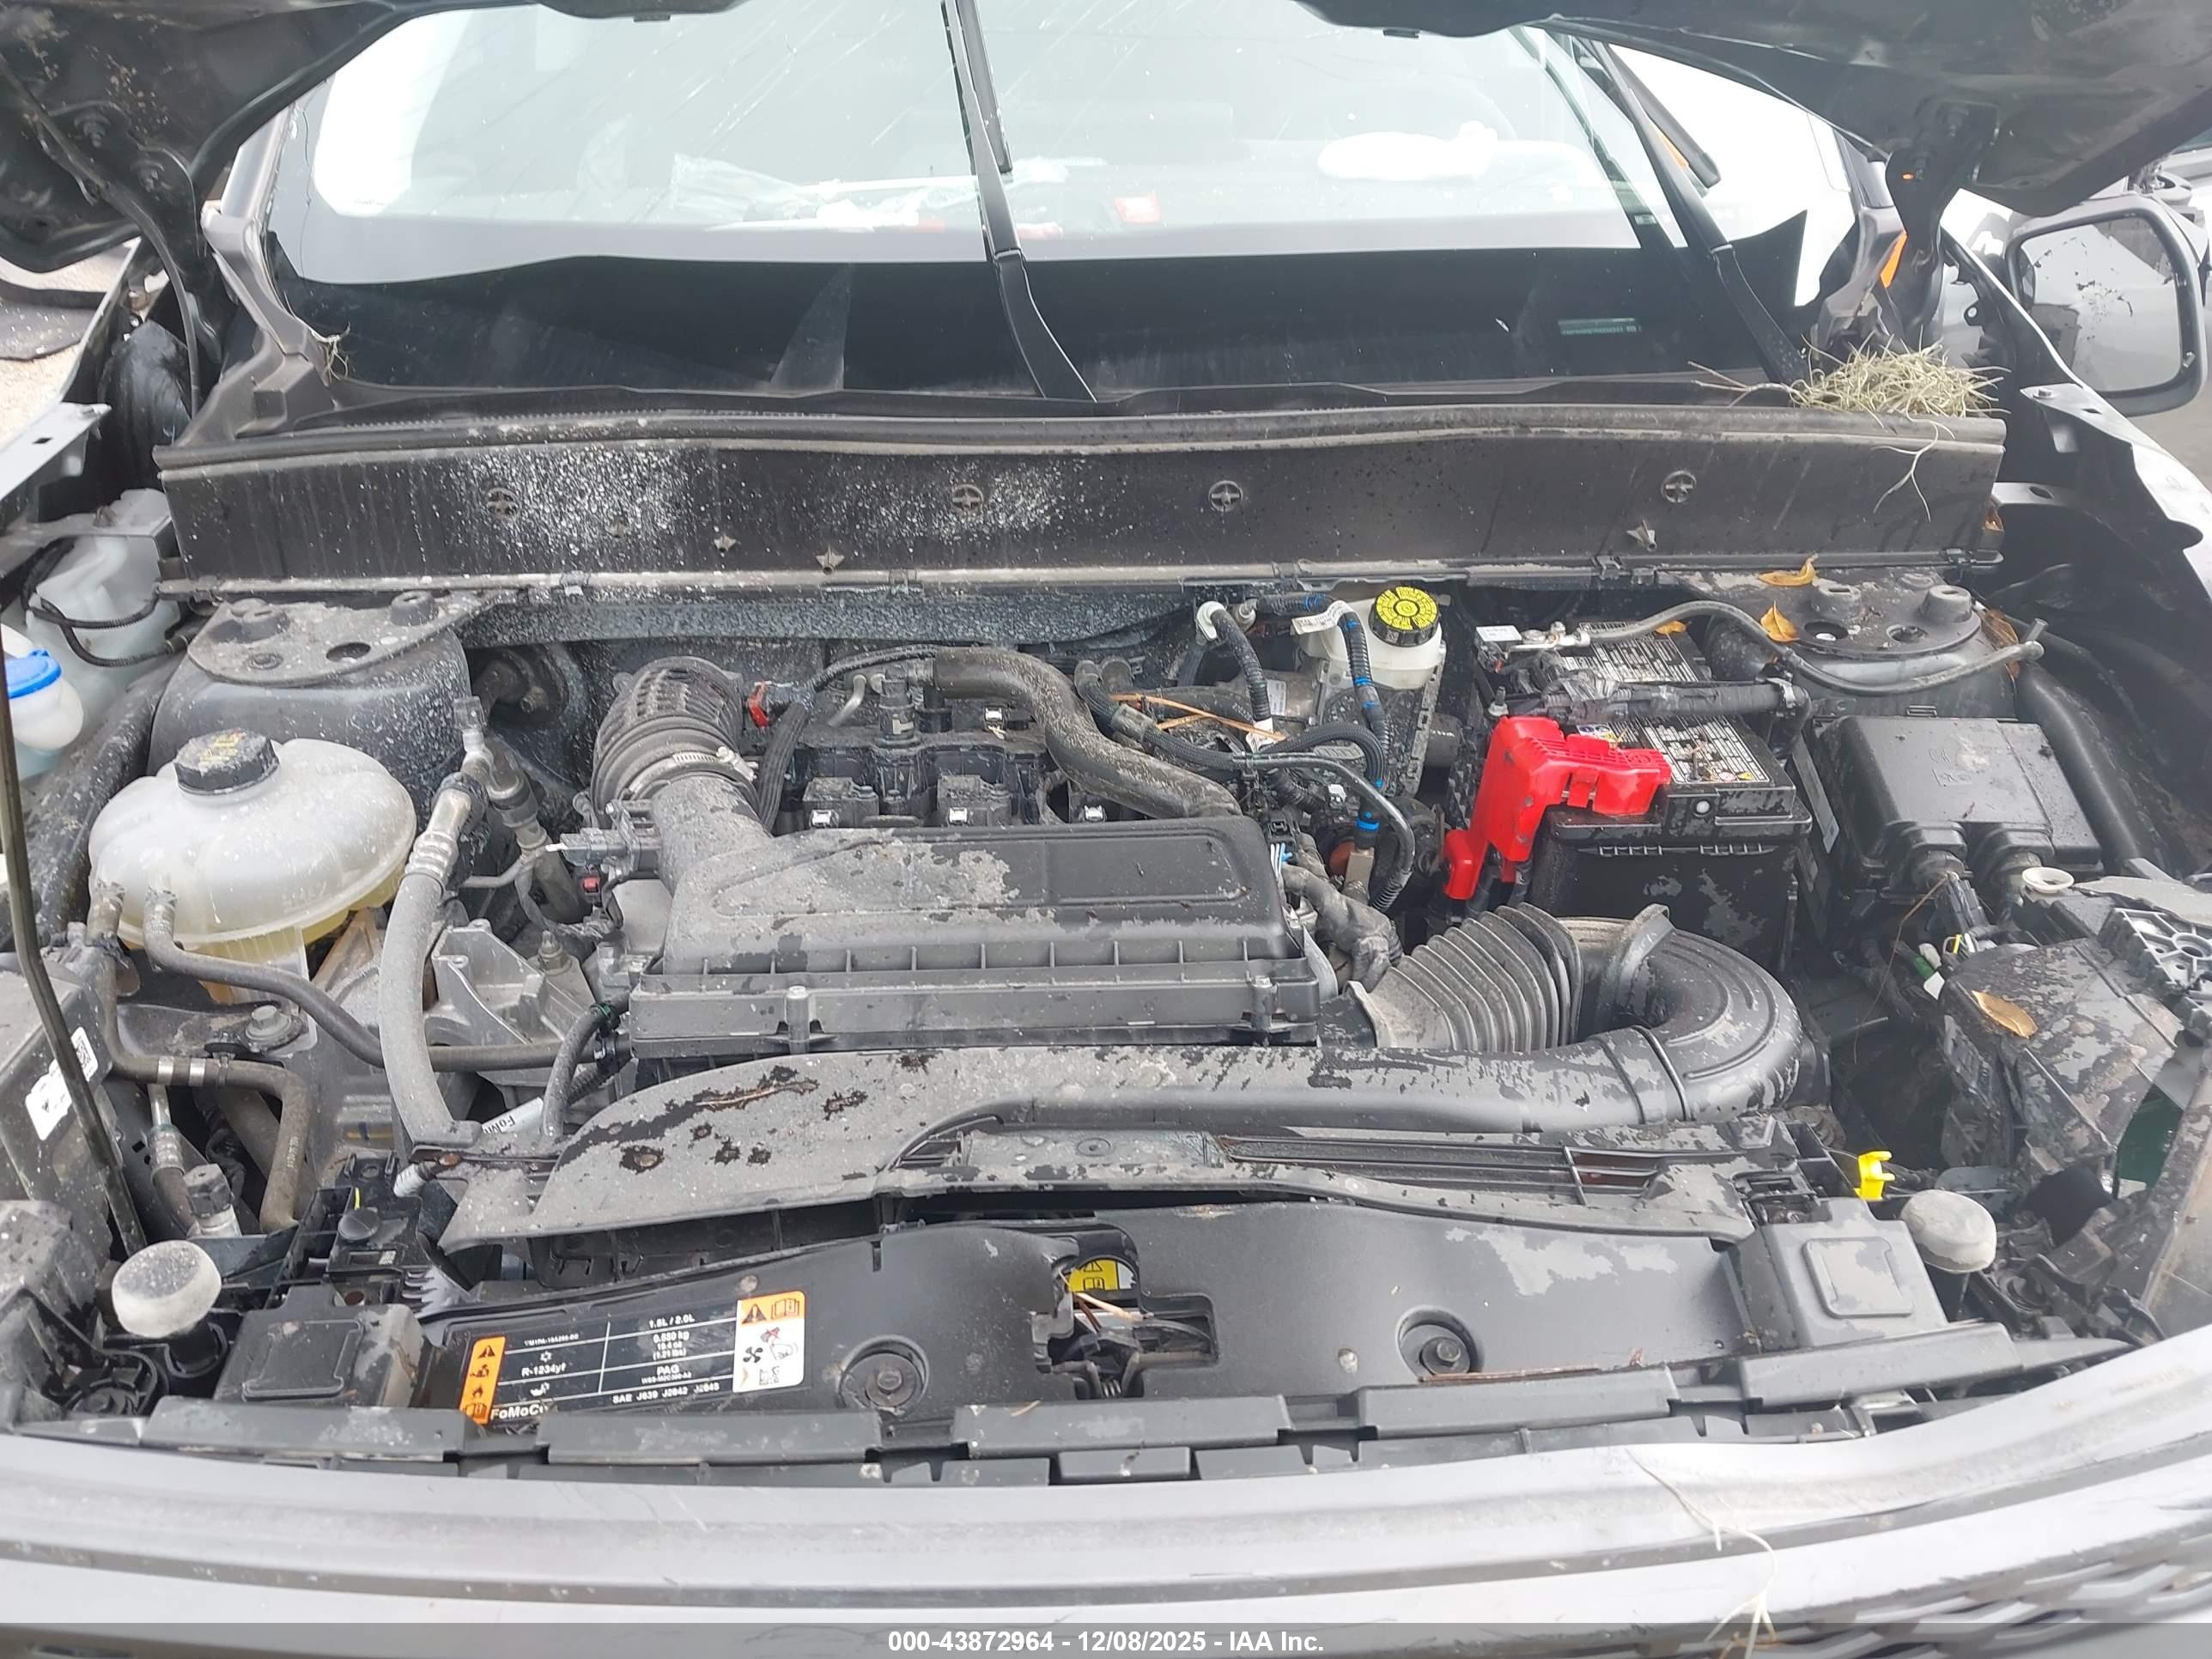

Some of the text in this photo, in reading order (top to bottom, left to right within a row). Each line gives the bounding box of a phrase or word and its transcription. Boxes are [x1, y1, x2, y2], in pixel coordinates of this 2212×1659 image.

[675, 1314, 695, 1325] 2.0L
[678, 1330, 690, 1341] kg
[521, 1362, 567, 1377] R-1234yf
[657, 1364, 680, 1376] PAG
[612, 1393, 633, 1404] SAE
